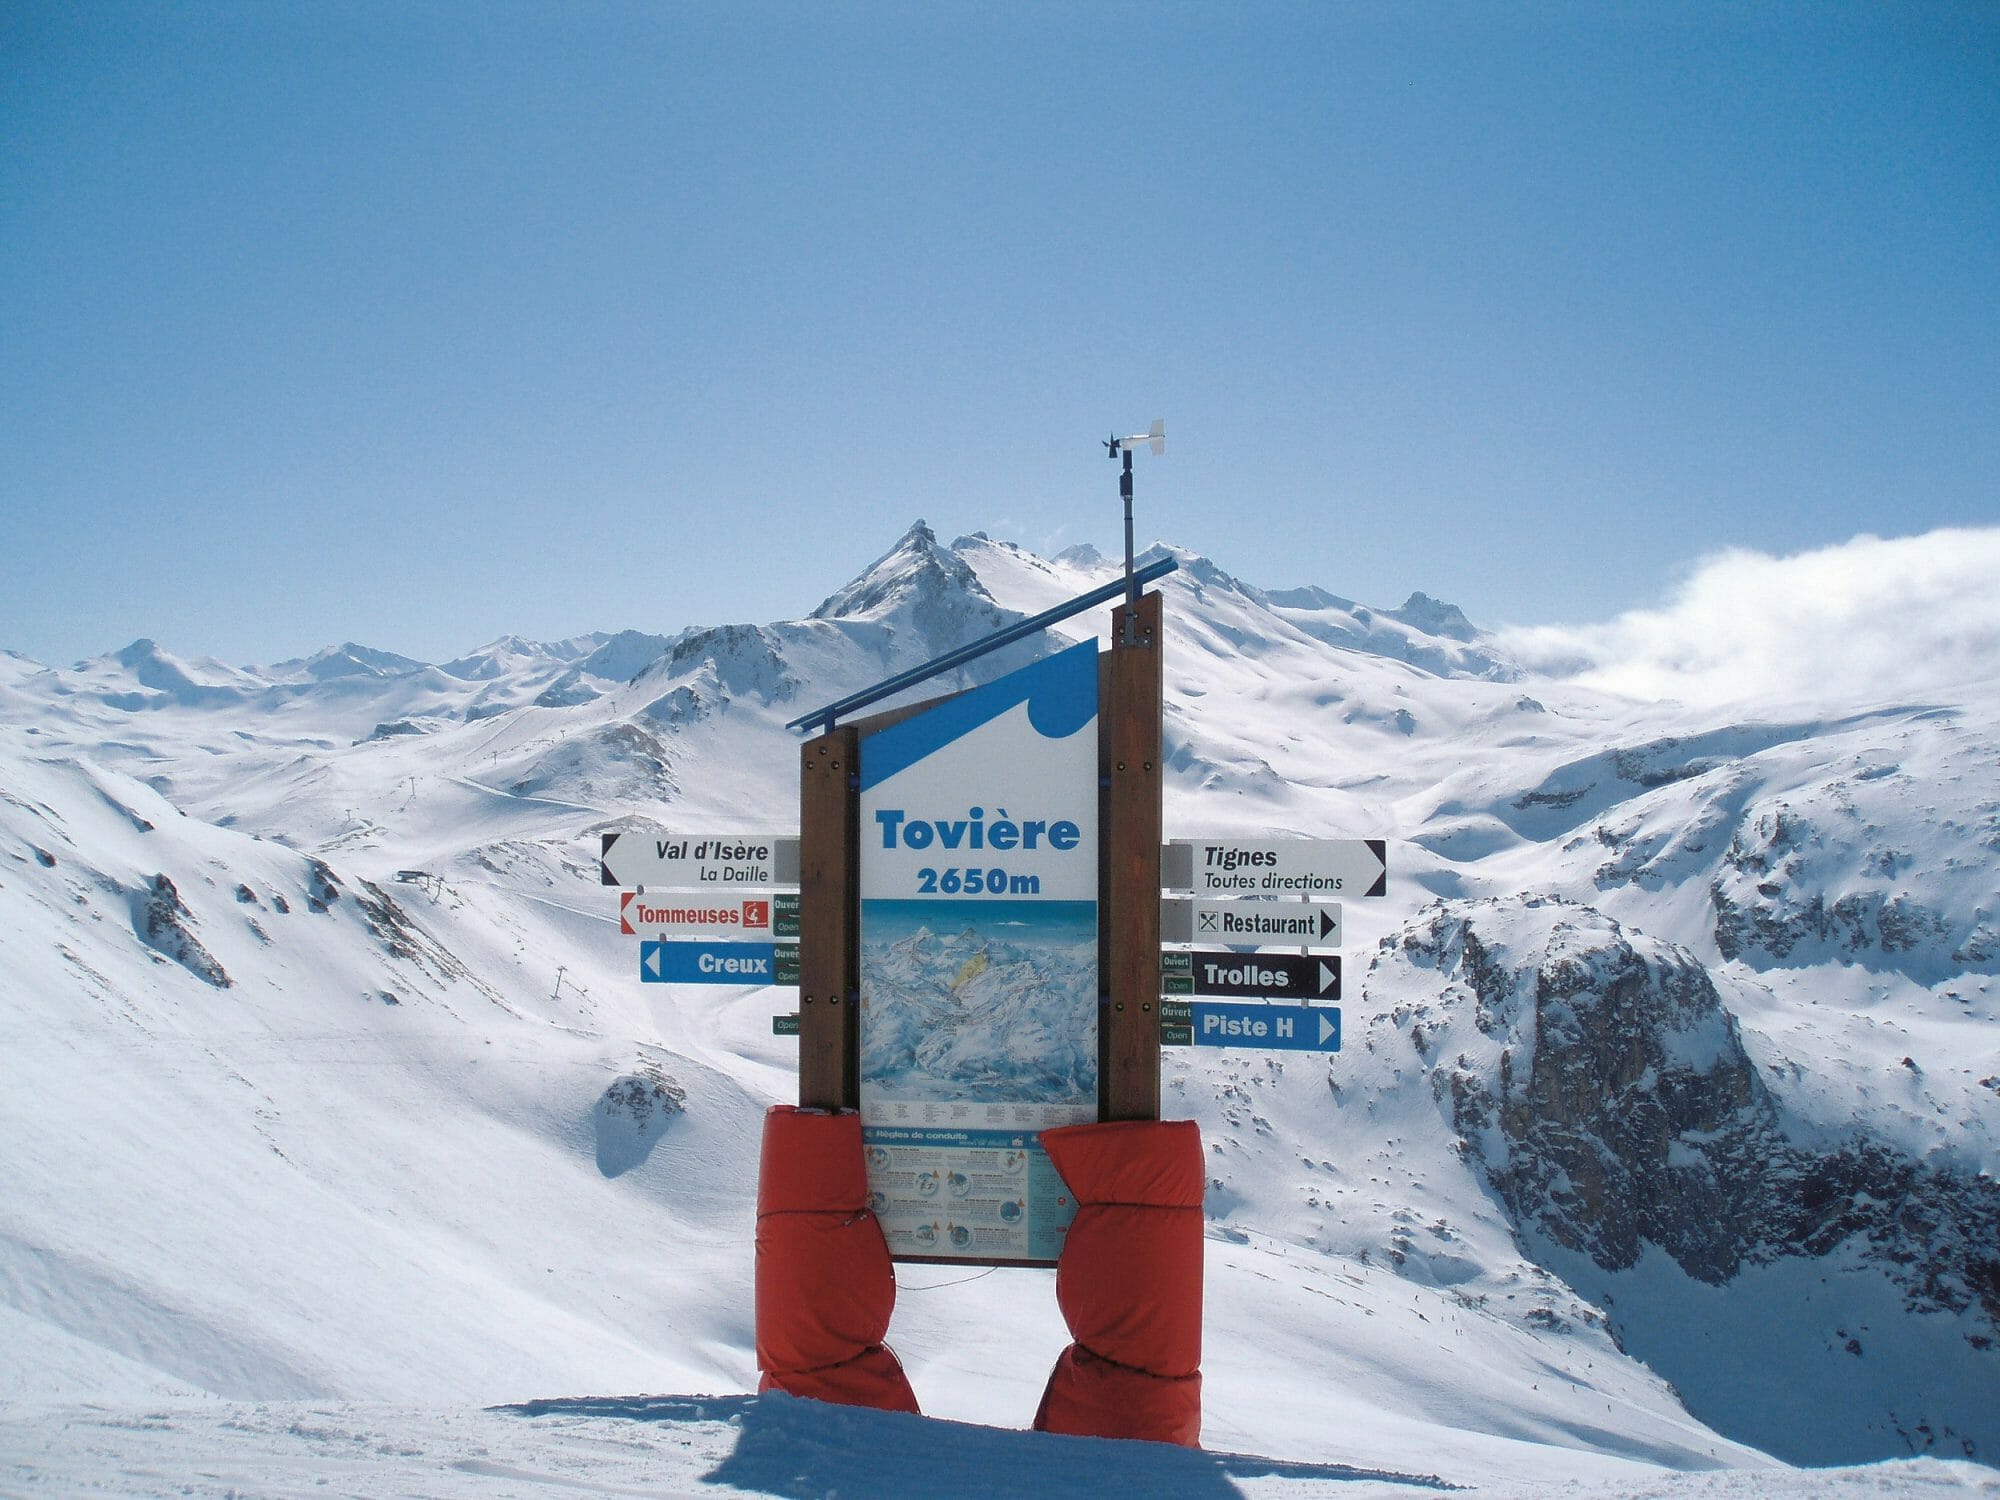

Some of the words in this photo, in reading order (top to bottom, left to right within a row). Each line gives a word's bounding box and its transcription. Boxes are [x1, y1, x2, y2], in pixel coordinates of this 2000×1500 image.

[875, 806, 1081, 850] Tovière
[656, 841, 687, 860] Val
[694, 840, 768, 861] d'Isère
[1205, 846, 1277, 870] Tignes
[700, 866, 717, 881] La
[723, 866, 768, 882] Daille
[917, 868, 1040, 894] 2650m
[1205, 872, 1256, 889] Toutes
[1261, 872, 1343, 890] directions
[774, 900, 800, 909] Ouver
[637, 904, 739, 924] Tommeuses
[778, 922, 799, 932] Open
[1223, 912, 1315, 935] Restaurant
[774, 948, 800, 958] Ouver
[699, 953, 768, 974] Creux
[1164, 957, 1189, 966] Ouvert
[778, 972, 799, 981] Open
[1204, 964, 1289, 986] Trolles
[1168, 981, 1188, 991] Open
[1161, 1007, 1191, 1017] Ouvert
[777, 1020, 799, 1030] Open
[1203, 1014, 1268, 1036] Piste
[1276, 1017, 1293, 1037] H
[1166, 1031, 1188, 1040] Open
[876, 1130, 909, 1140] Règles
[911, 1131, 924, 1139] de
[926, 1132, 968, 1140] conduite
